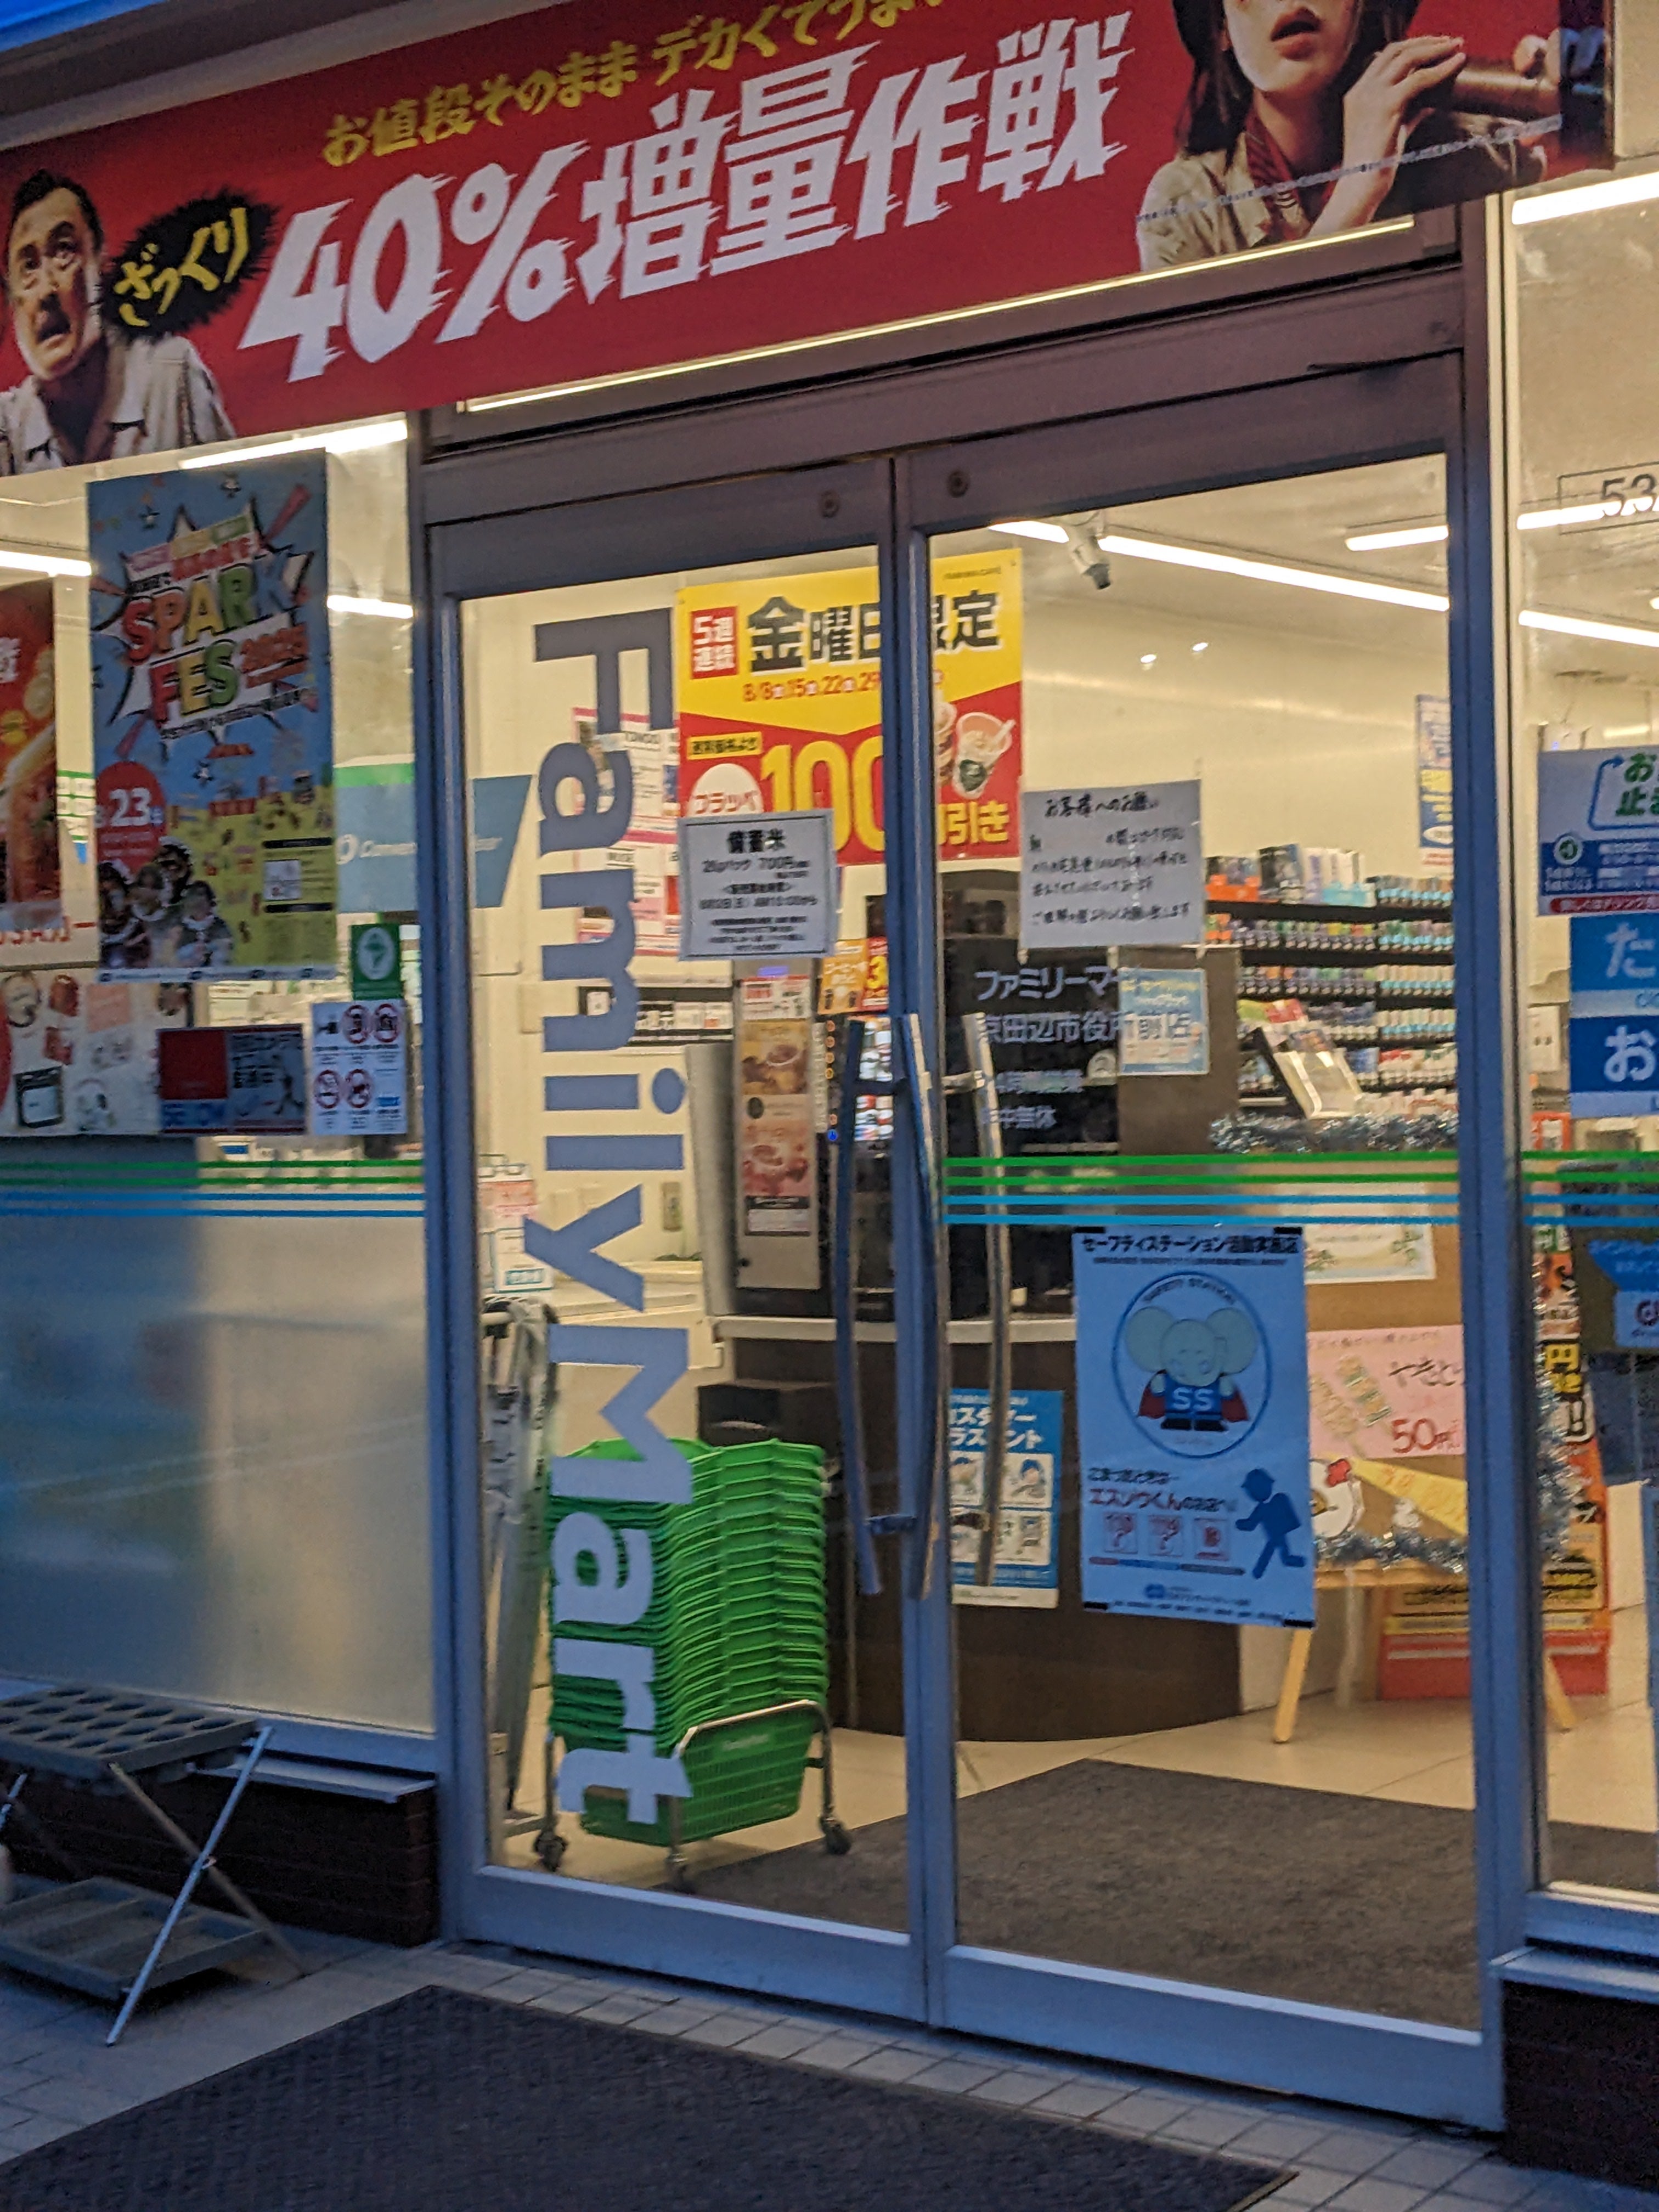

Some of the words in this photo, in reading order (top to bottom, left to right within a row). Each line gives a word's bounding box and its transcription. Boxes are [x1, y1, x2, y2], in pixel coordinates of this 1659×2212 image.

[237, 10, 1135, 383] 40%増量作戦
[323, 43, 637, 167] お値段そのまま
[523, 606, 695, 1825] FamilyMart
[1172, 1386, 1214, 1412] SS
